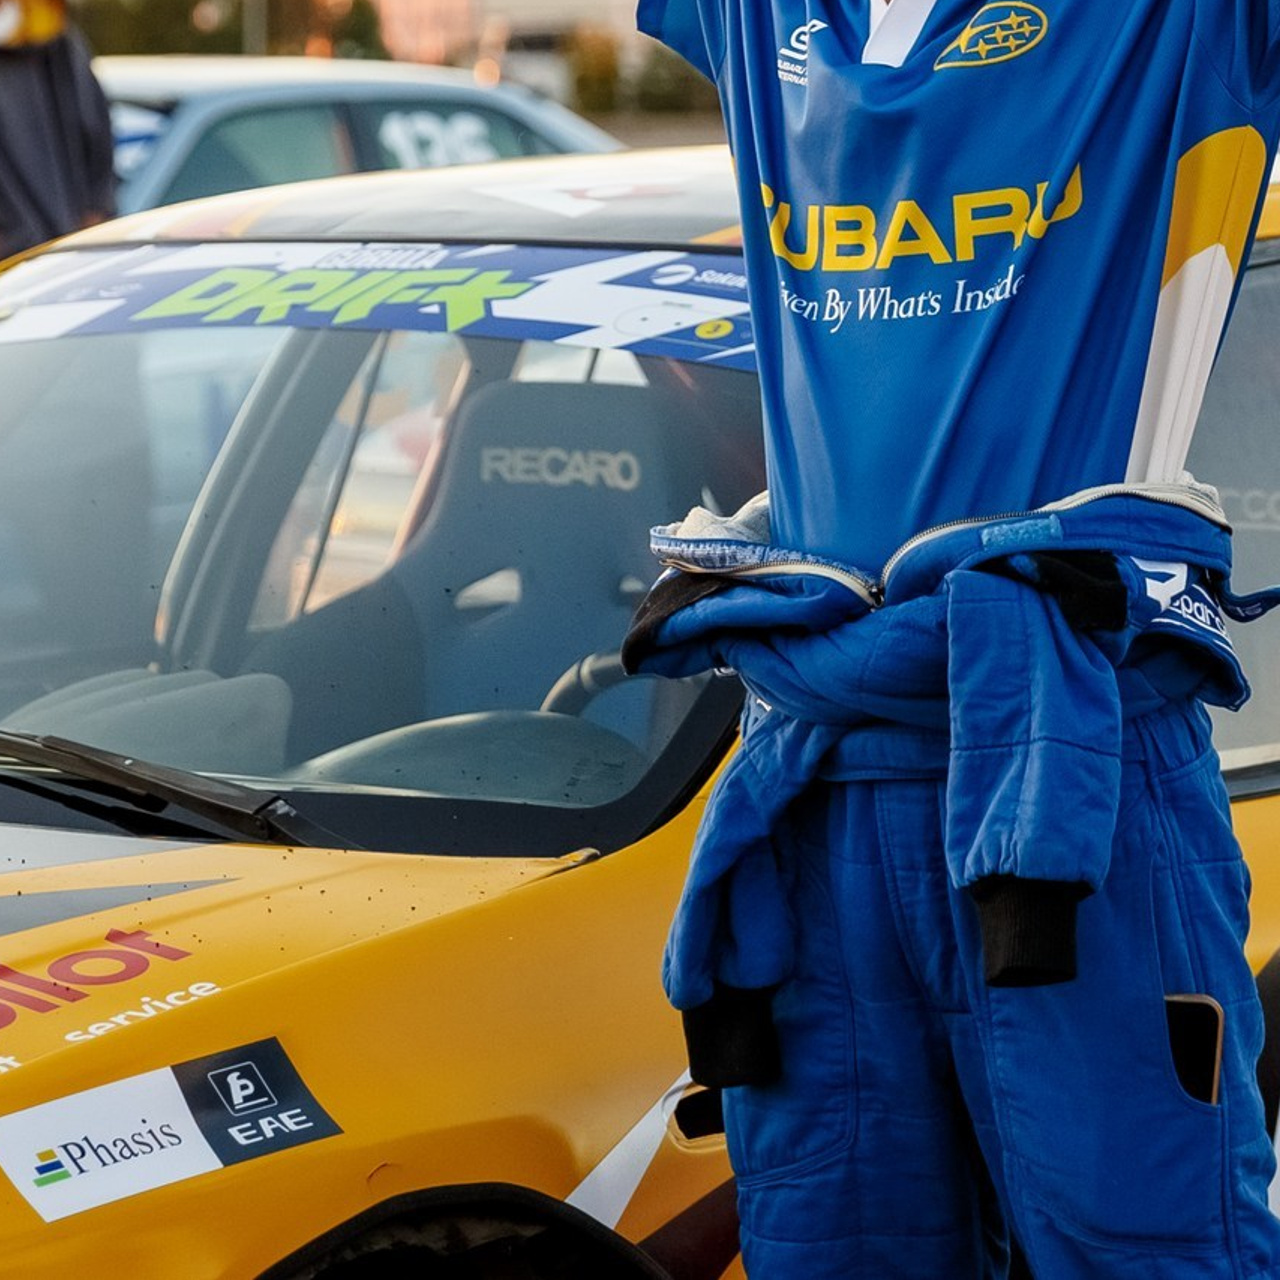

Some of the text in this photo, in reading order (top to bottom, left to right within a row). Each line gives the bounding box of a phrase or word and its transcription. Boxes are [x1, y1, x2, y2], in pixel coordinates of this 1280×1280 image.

[760, 163, 1084, 271] UBARU
[128, 267, 536, 333] DRIFT
[822, 288, 852, 333] By
[857, 285, 941, 322] What's
[481, 447, 641, 491] RECARO
[64, 981, 222, 1043] service
[59, 1119, 183, 1175] Phasis
[227, 1108, 314, 1145] EAE
